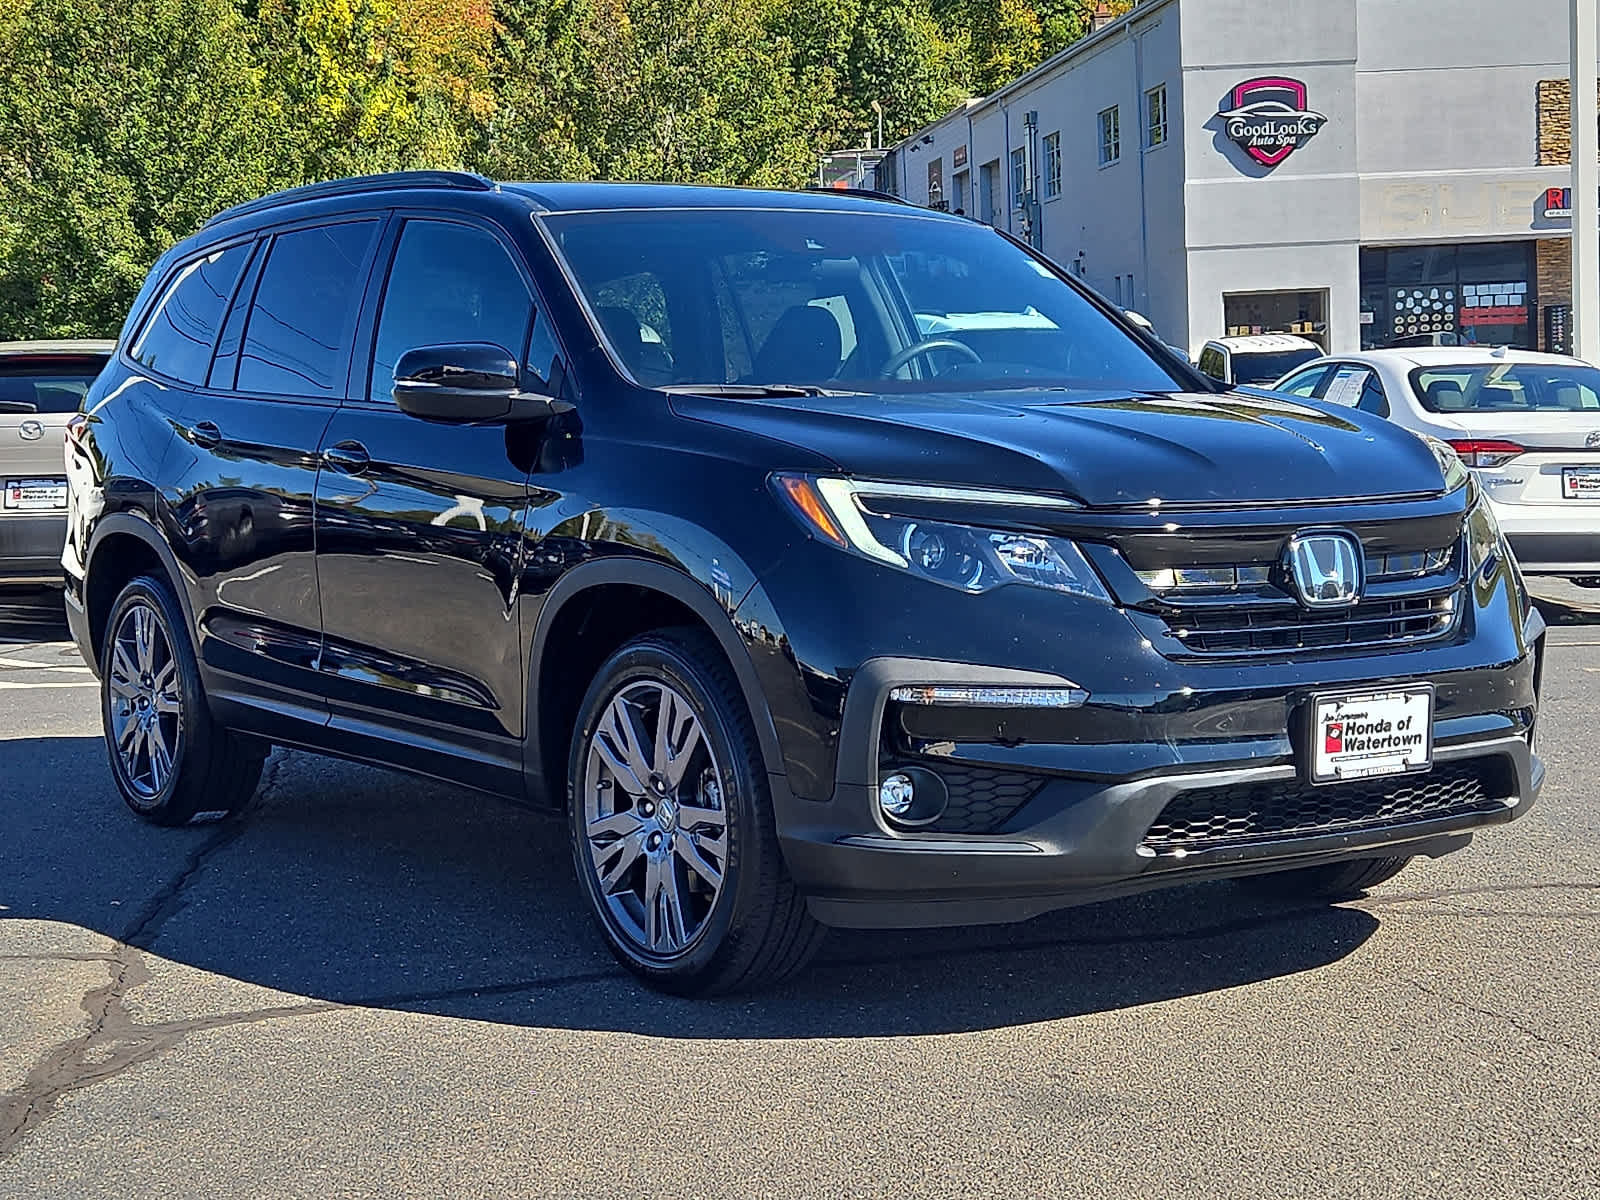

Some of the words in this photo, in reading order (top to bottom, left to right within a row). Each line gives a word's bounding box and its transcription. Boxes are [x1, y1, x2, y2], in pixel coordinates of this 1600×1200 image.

[1248, 135, 1274, 146] Auto
[1276, 134, 1296, 146] Spa
[1344, 718, 1392, 736] Honda
[1397, 716, 1412, 730] of
[1344, 734, 1422, 752] Watertown
